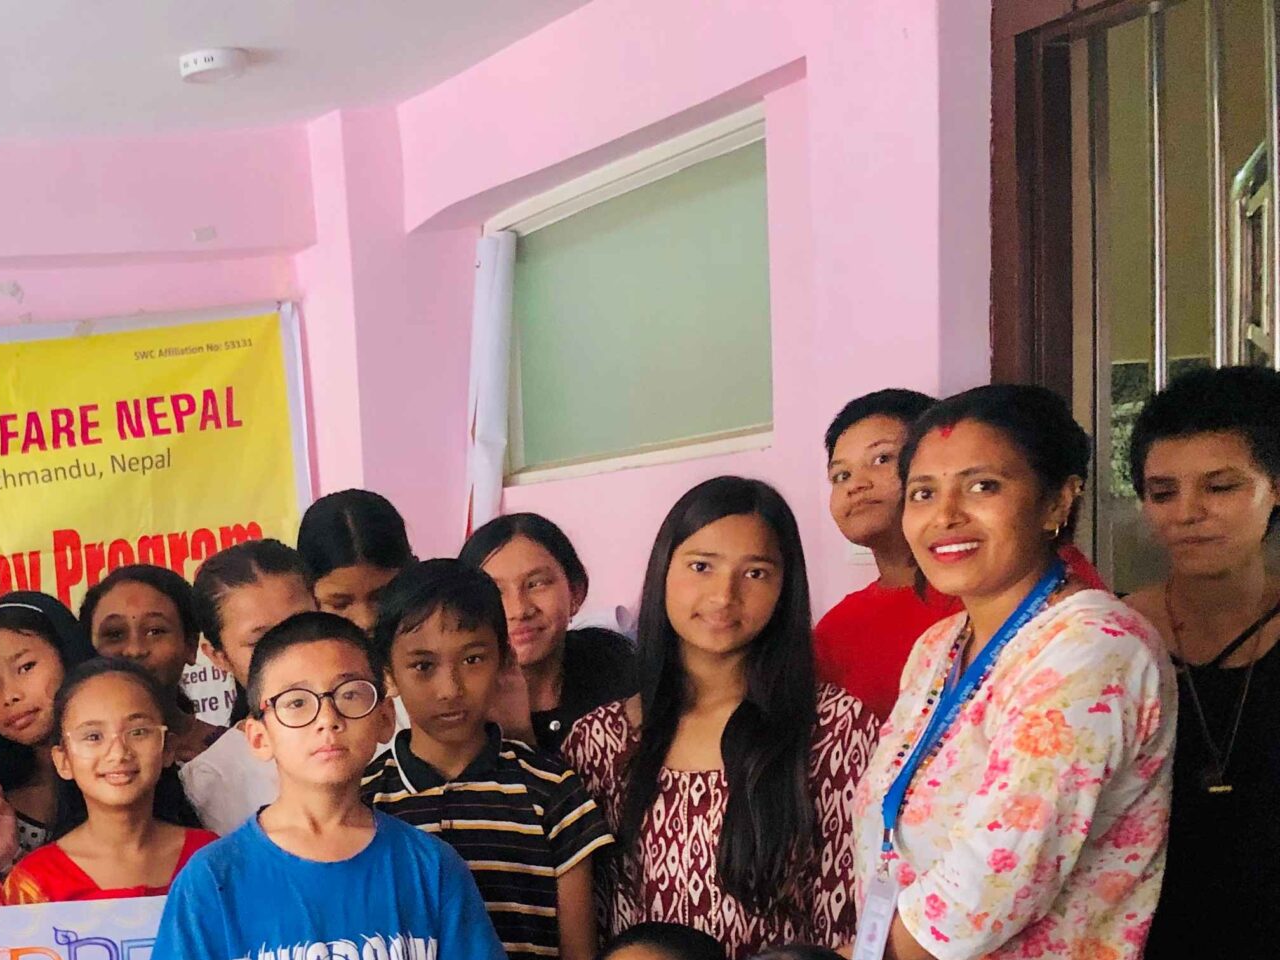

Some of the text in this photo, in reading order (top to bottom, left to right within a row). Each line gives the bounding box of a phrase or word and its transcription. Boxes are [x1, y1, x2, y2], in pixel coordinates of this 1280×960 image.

[134, 349, 155, 361] SWC
[158, 345, 204, 358] Affiliation
[224, 338, 253, 351] 53131
[115, 386, 243, 441] NEPAL
[109, 448, 172, 475] Nepal
